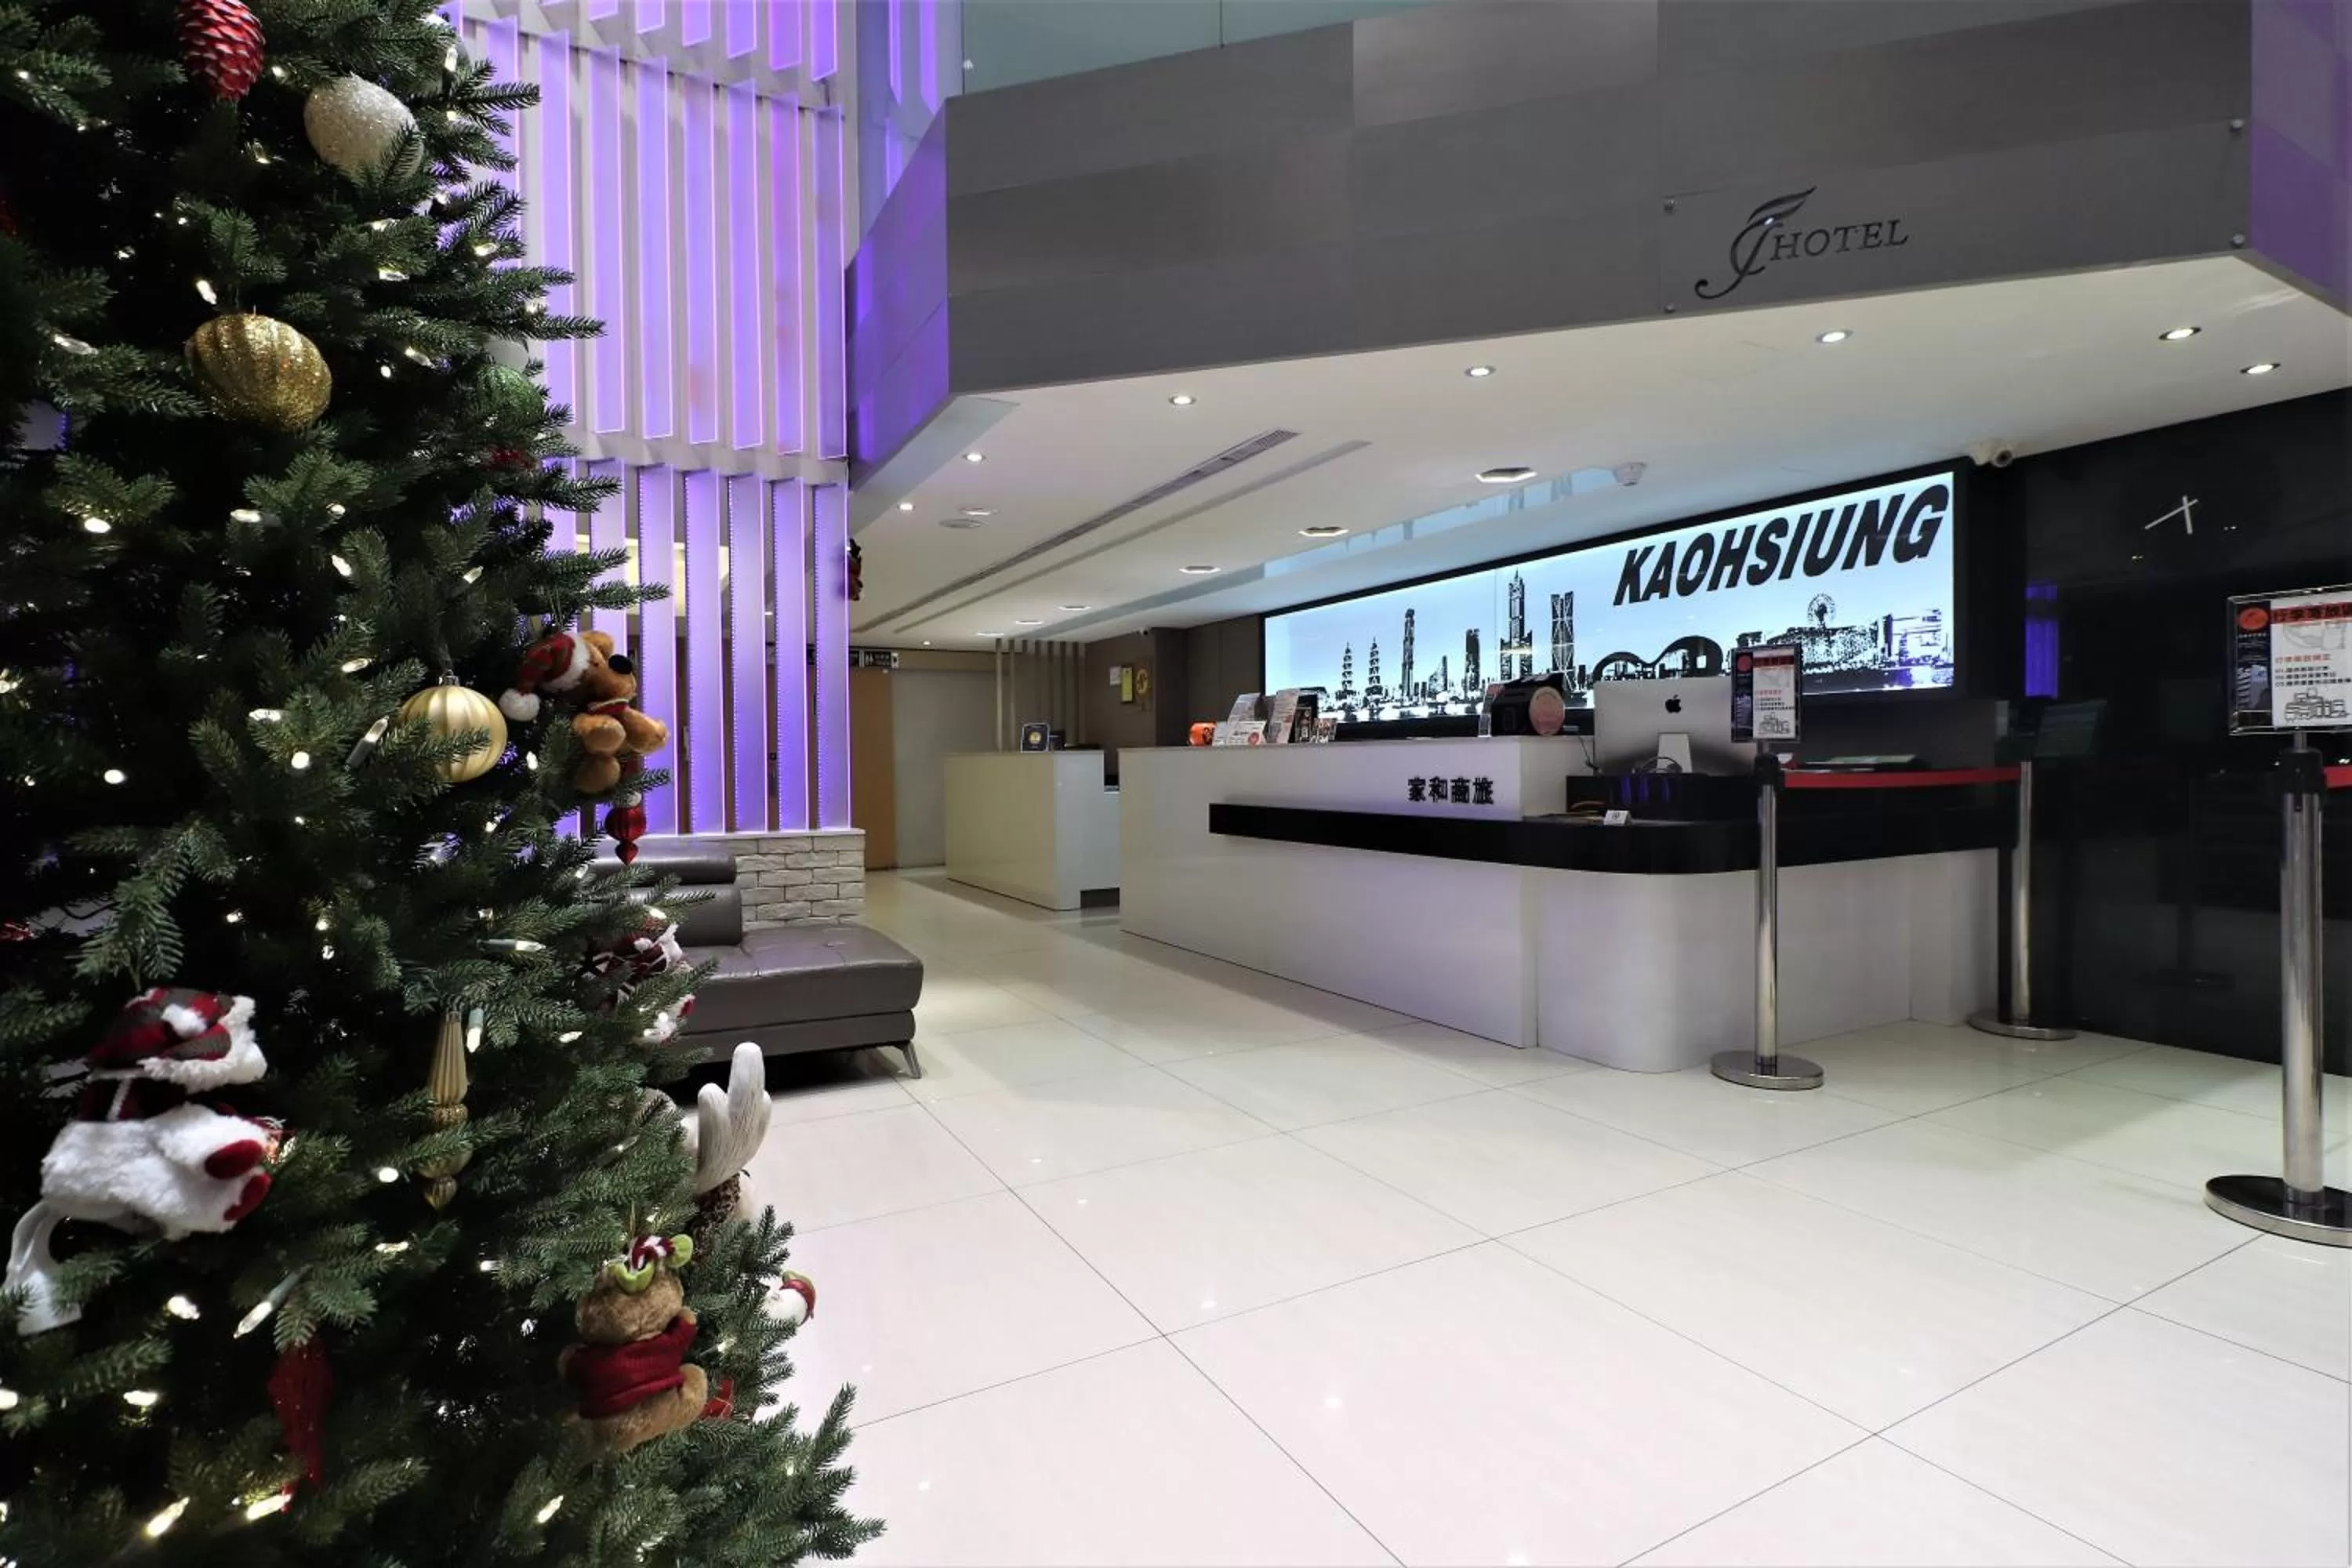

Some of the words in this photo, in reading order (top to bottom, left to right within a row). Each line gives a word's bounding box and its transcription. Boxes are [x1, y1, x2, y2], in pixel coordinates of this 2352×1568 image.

[1769, 219, 1909, 261] HOTEL
[1613, 484, 1950, 606] KAOHSIUNG
[1407, 776, 1494, 804] 家和商旅
